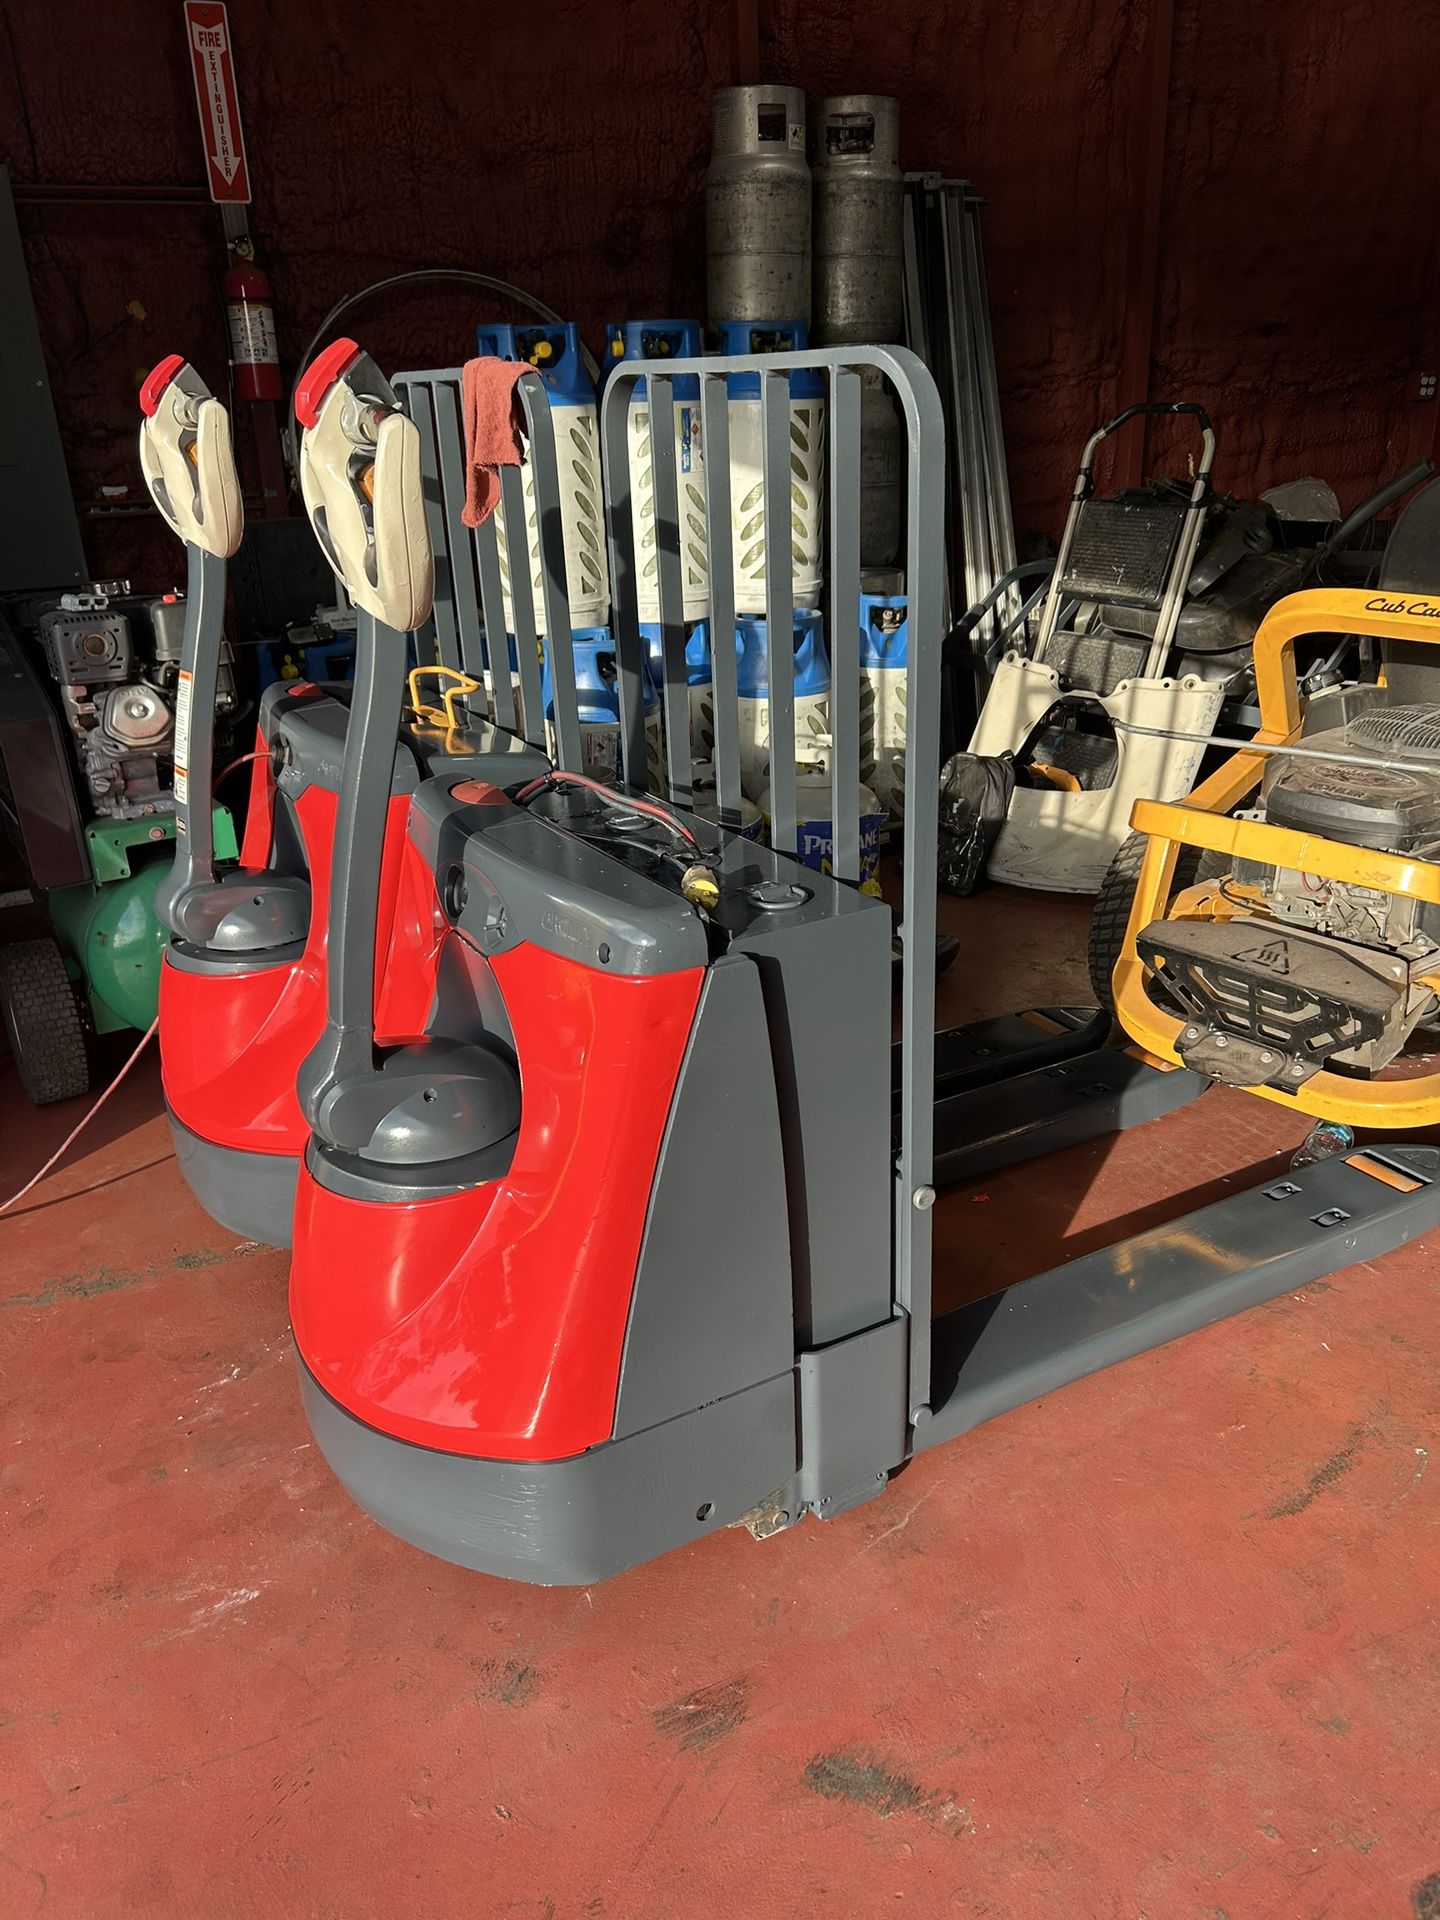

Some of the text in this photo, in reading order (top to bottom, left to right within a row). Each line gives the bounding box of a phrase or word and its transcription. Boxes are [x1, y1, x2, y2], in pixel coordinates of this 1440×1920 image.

[198, 31, 222, 48] FIRE
[209, 51, 232, 177] EXTINGUISHER
[1365, 598, 1440, 617] Cub Ca
[803, 829, 878, 855] PRANE
